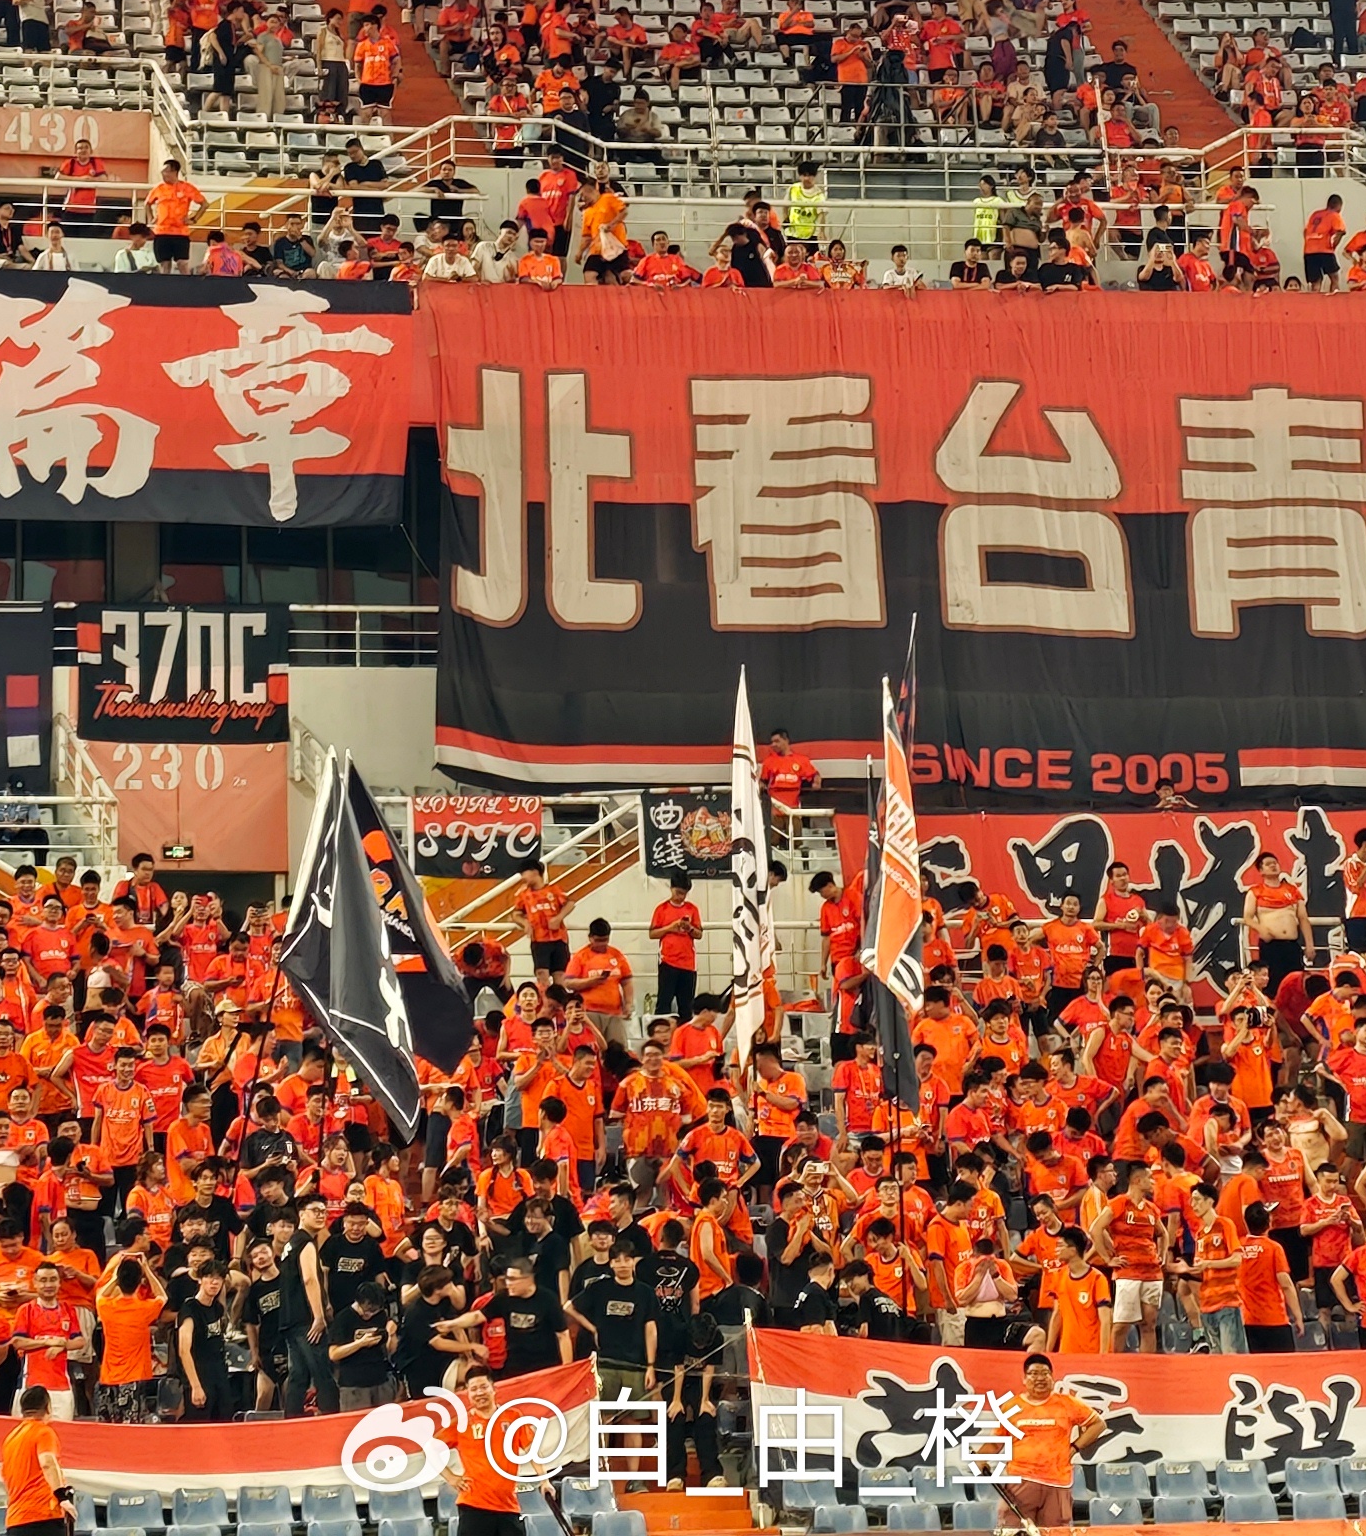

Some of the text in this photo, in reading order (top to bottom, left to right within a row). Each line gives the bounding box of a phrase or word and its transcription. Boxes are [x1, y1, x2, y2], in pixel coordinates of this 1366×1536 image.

[4, 111, 100, 153] 430
[112, 742, 226, 791] 230
[904, 741, 1230, 796] SINCE 2005
[413, 795, 541, 815] LOYAL TO
[416, 820, 540, 863] STFC
[471, 1423, 485, 1440] 12
